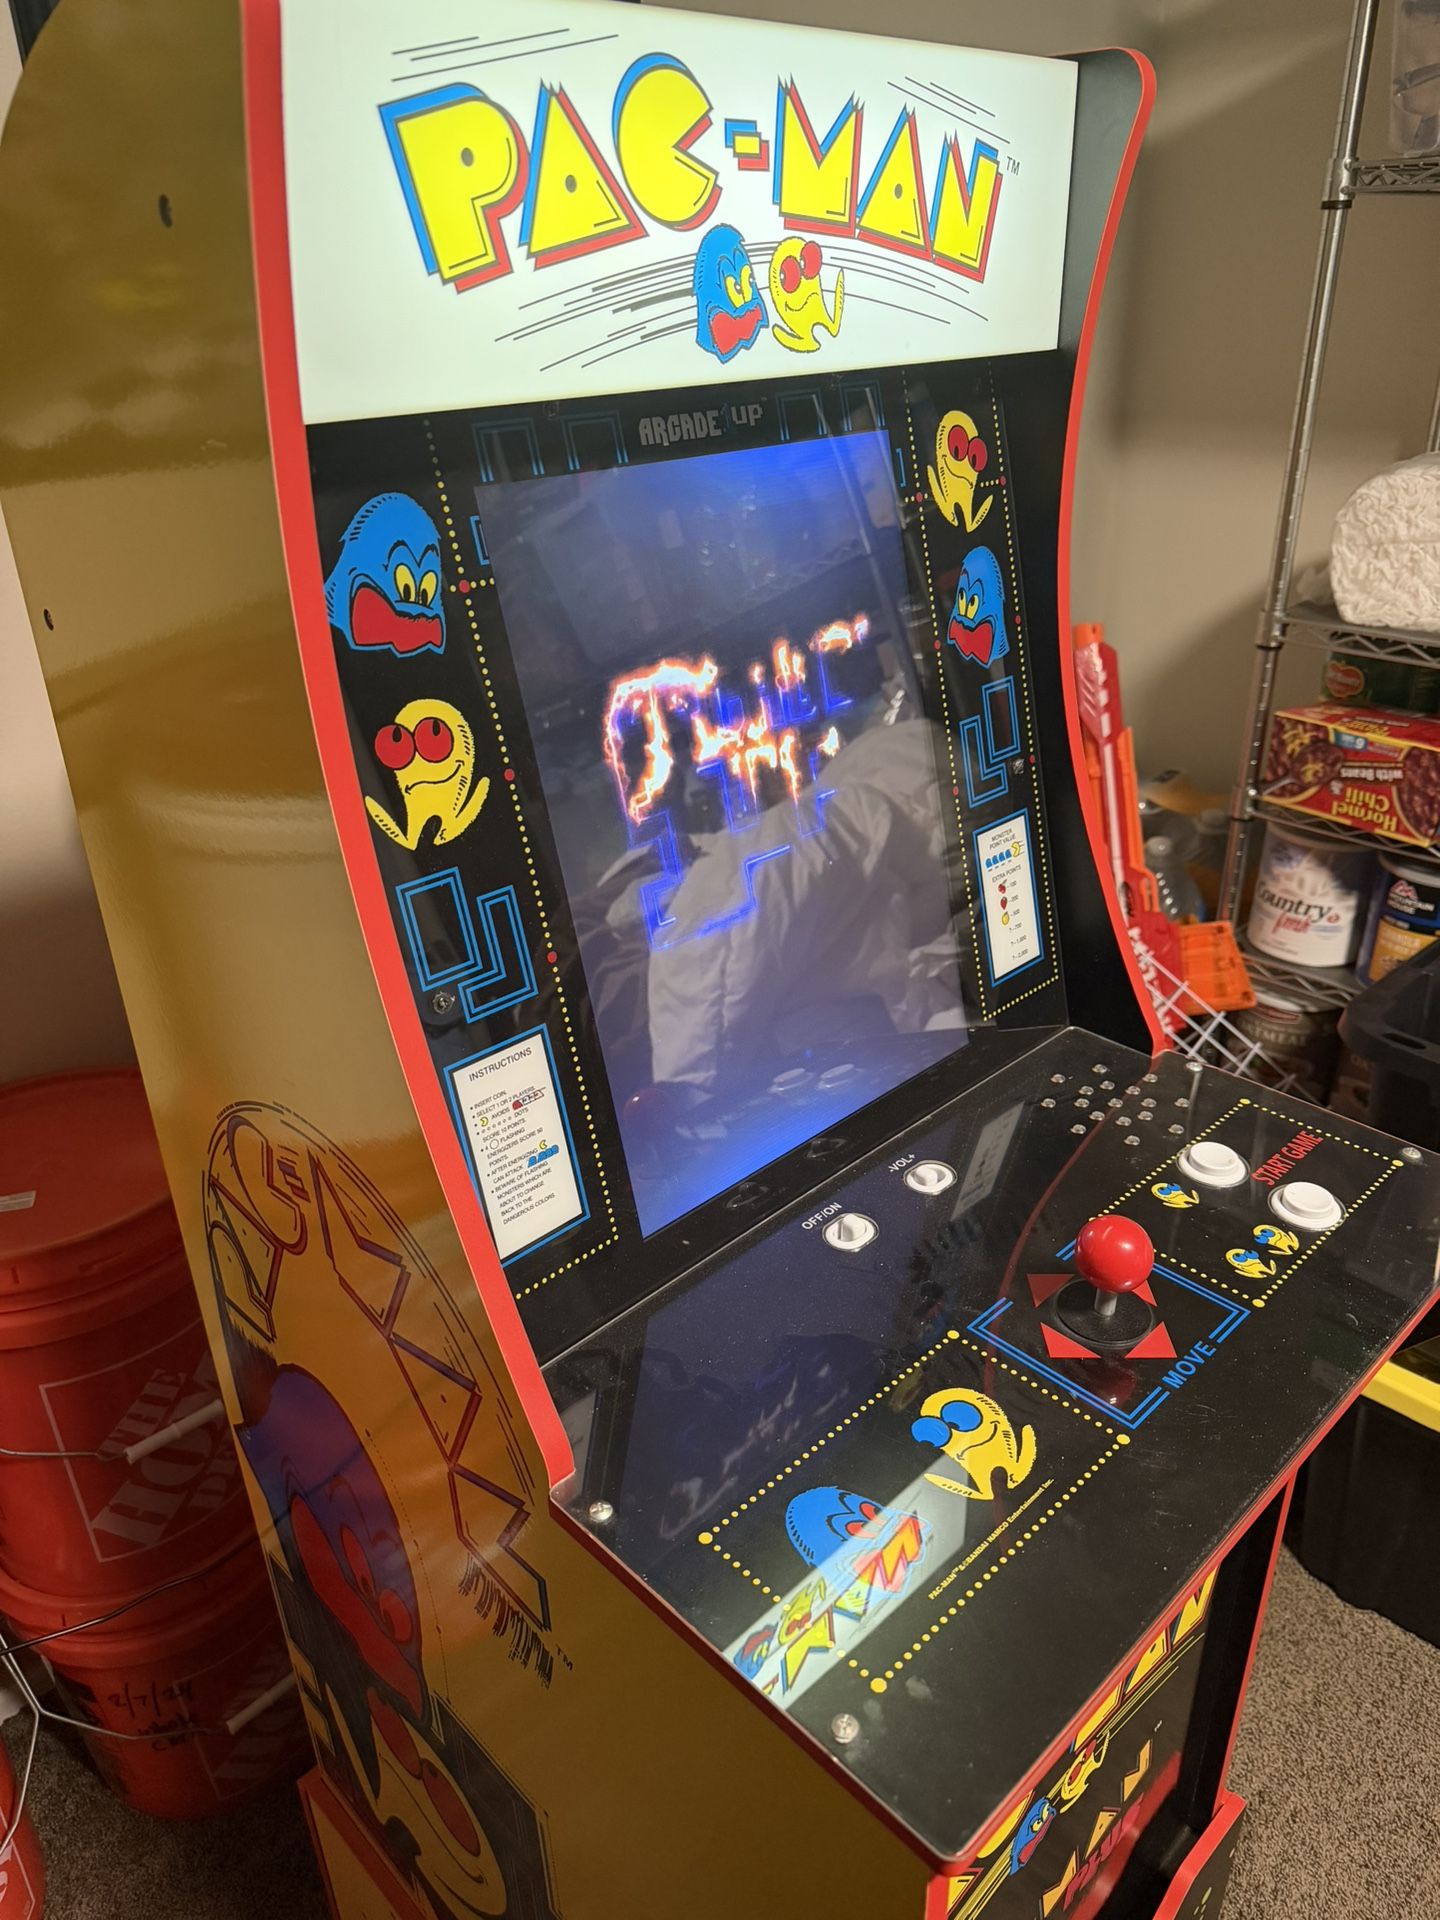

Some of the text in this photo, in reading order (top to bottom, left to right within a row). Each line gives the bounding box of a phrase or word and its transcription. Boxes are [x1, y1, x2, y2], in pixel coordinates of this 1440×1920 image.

[377, 52, 1002, 294] PAC-MAN
[1332, 801, 1397, 831] Hormel
[1345, 787, 1390, 812] Chili
[469, 1047, 532, 1082] INSTRUCTIONS
[1251, 1130, 1323, 1186] START GAME
[801, 1202, 842, 1230] OFF/ON
[1161, 1340, 1217, 1389] MOVE
[1006, 1487, 1045, 1523] Entertainment
